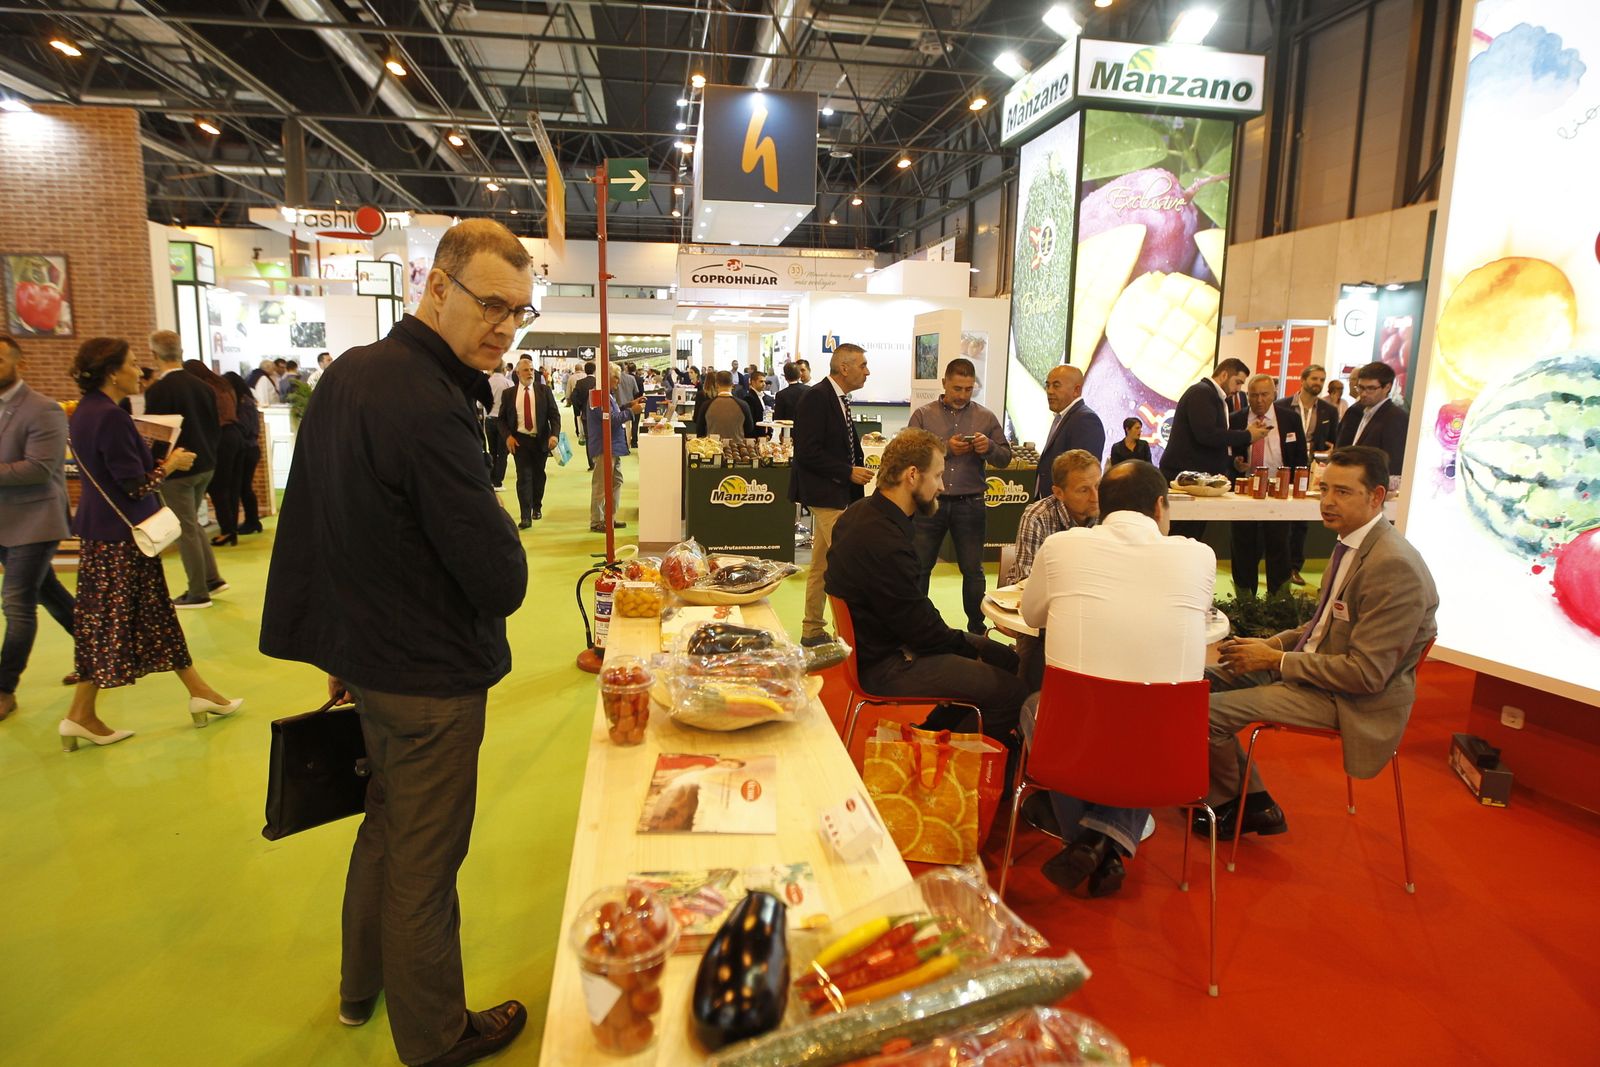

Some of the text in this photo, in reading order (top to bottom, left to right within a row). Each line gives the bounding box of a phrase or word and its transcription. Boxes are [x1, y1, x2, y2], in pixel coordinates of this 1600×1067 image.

[1090, 60, 1254, 103] Manzano
[1006, 72, 1070, 134] Manzano
[1106, 176, 1187, 218] Exclusive
[691, 273, 778, 286] COPROHNÍJAR
[626, 345, 663, 354] Gruventa
[712, 491, 773, 501] Manzano
[983, 493, 1028, 502] anzano
